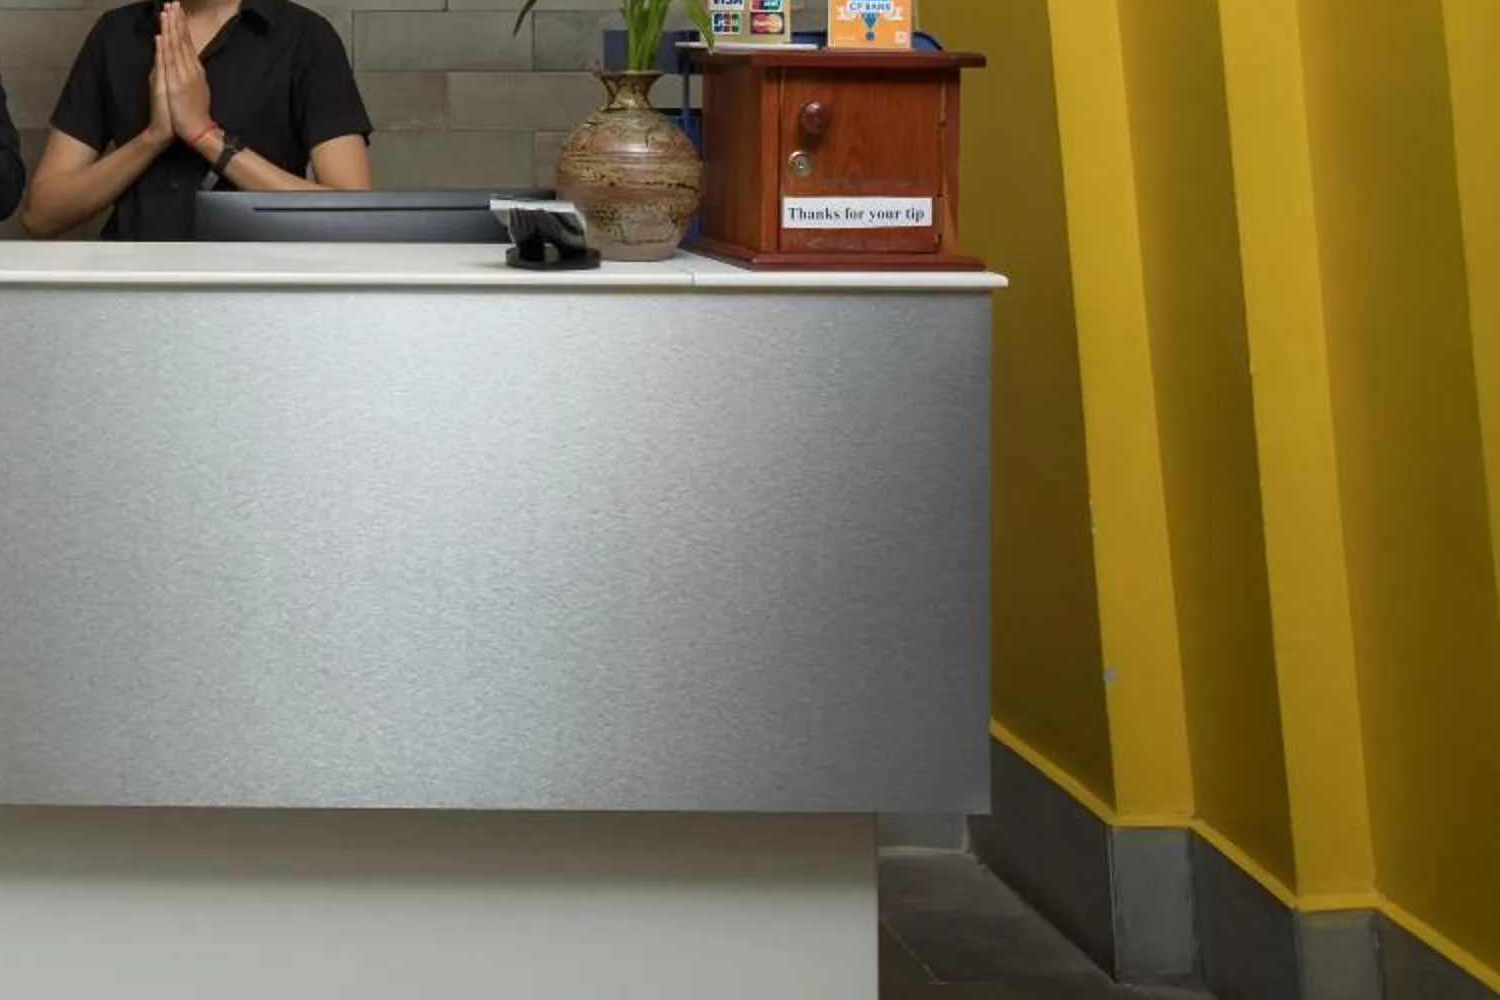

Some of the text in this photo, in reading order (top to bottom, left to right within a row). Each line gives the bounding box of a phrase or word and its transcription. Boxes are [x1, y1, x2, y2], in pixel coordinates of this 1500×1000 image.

[788, 207, 925, 222] Thanks for your tip
